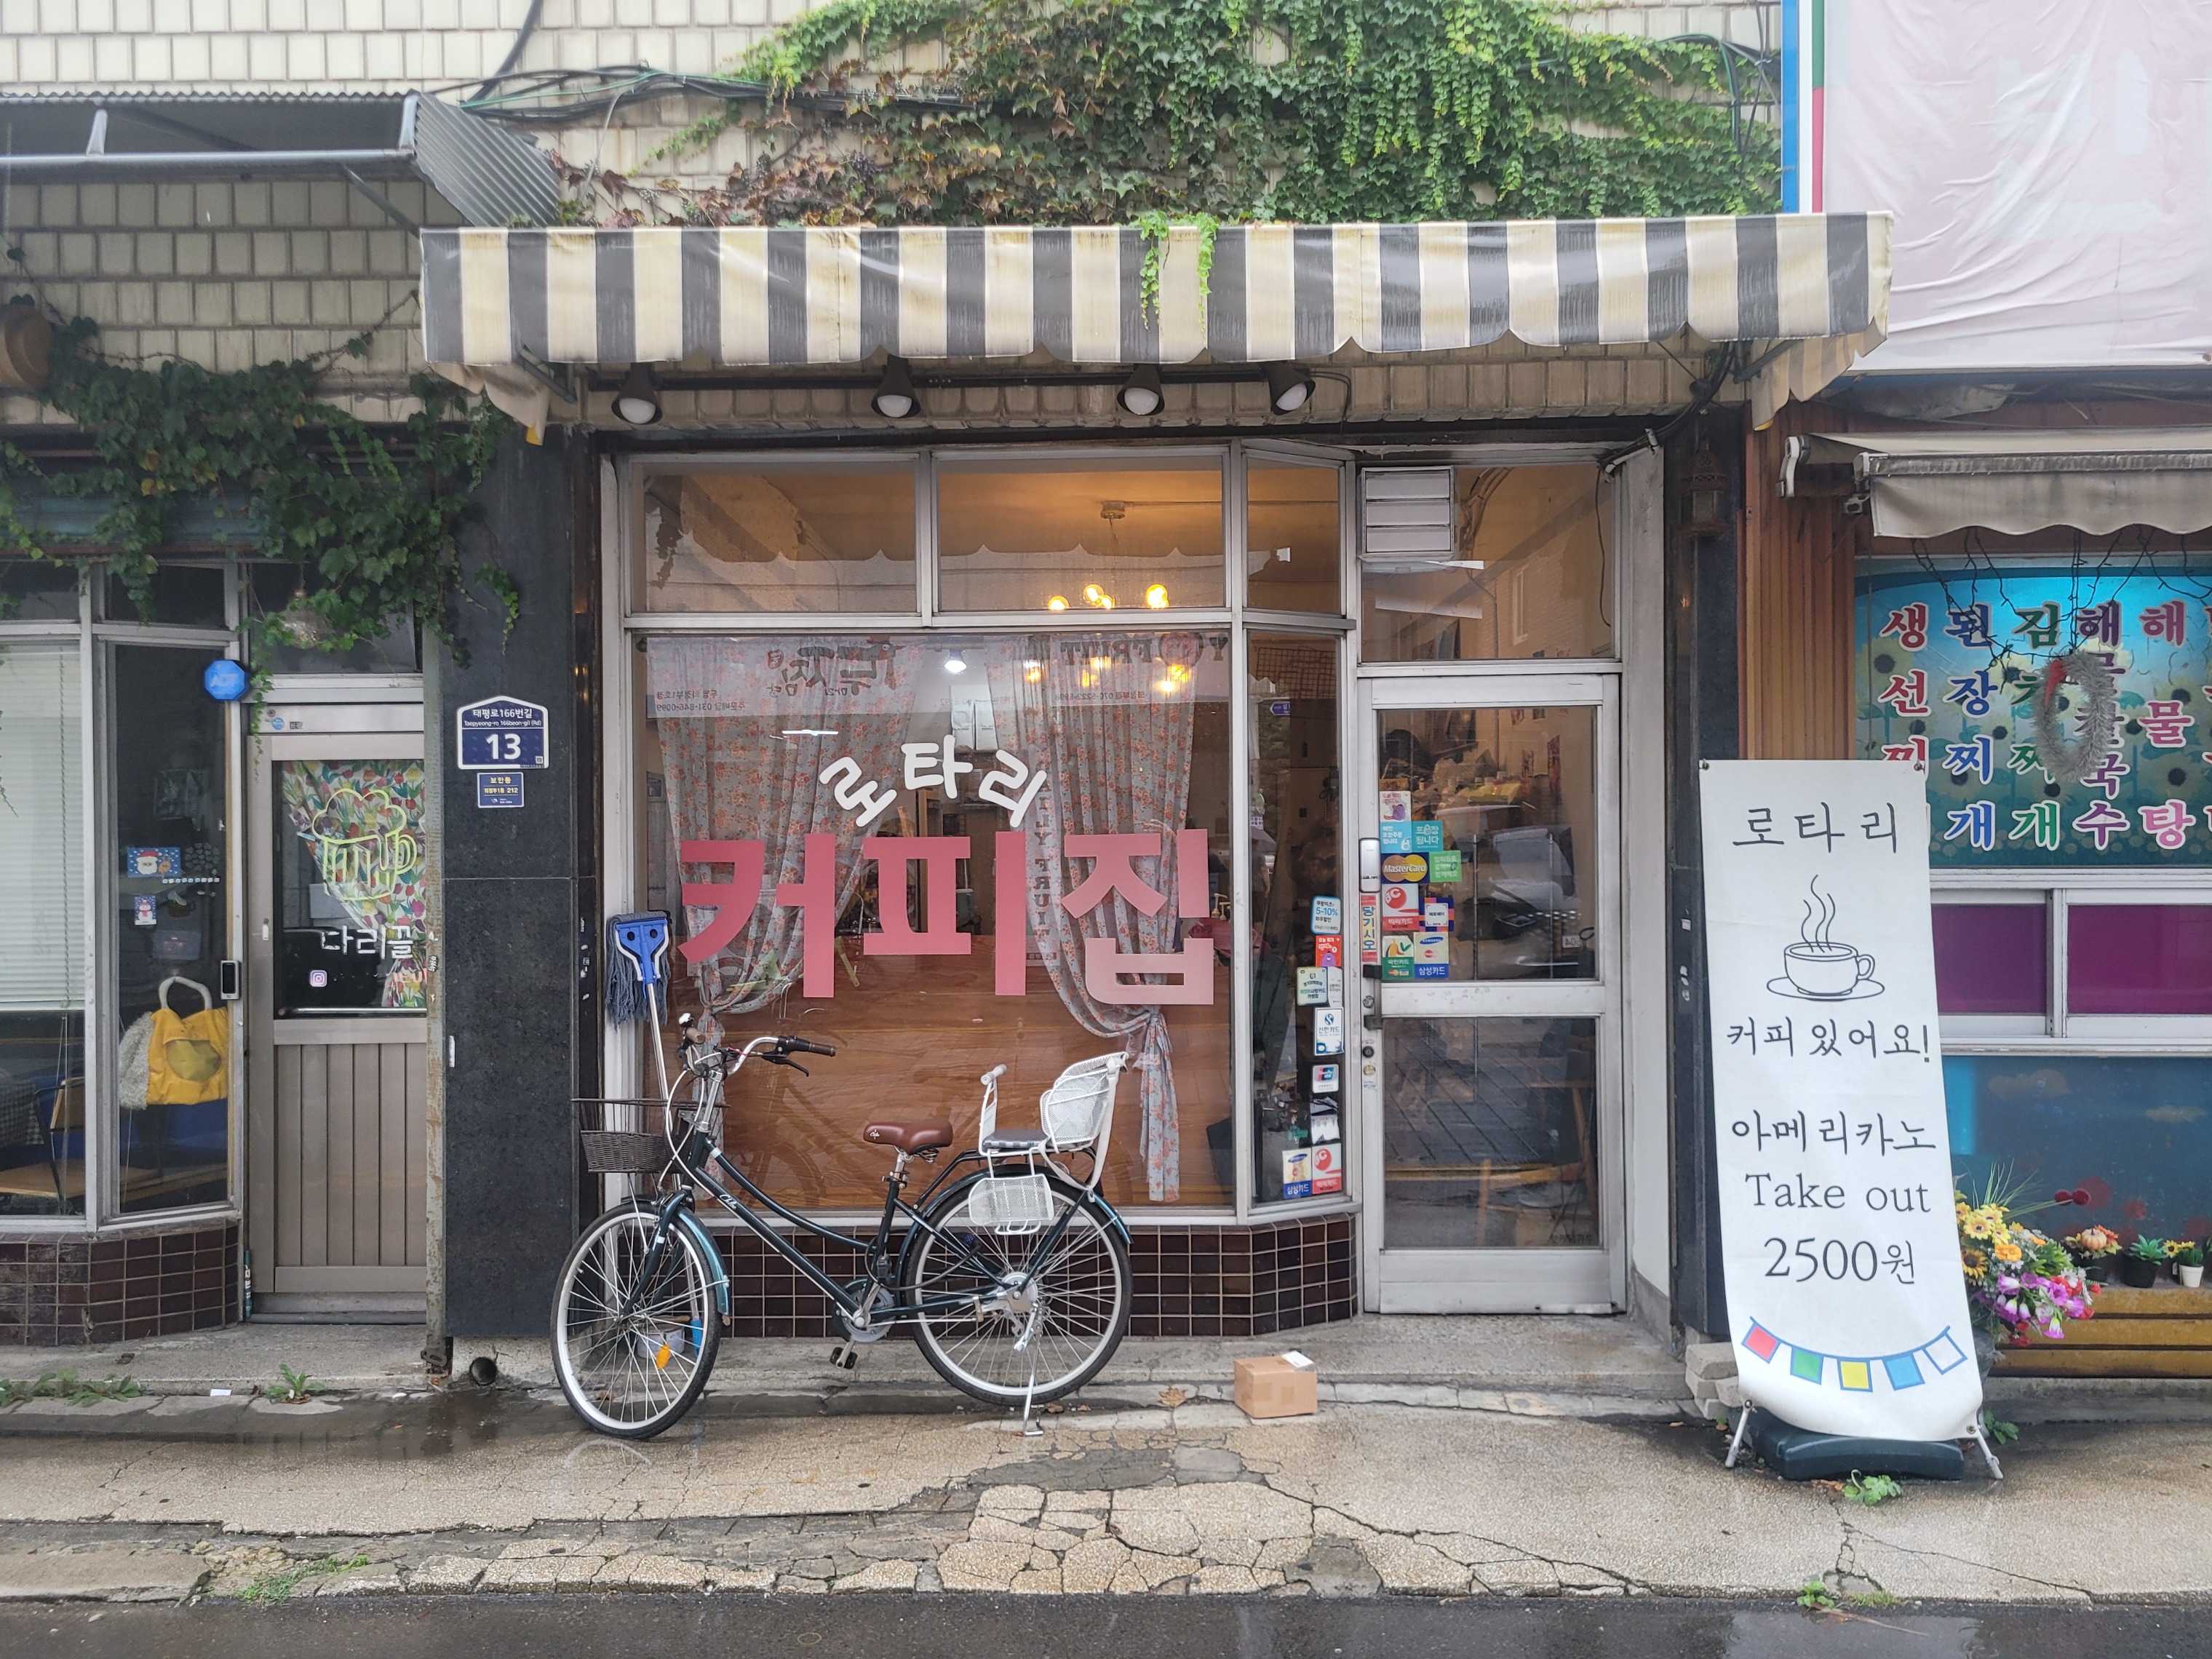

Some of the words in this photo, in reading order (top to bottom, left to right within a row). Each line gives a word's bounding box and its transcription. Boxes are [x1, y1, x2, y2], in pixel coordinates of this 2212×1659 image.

[472, 708, 533, 719] 태평로166번길
[1945, 604, 1999, 847] 된장찌개
[2139, 600, 2193, 843] 해물탕
[485, 733, 521, 760] 13
[819, 734, 1046, 827] 로타리
[1416, 835, 1439, 845] 됩니다
[1732, 801, 1897, 854] 로타리
[1383, 864, 1425, 873] MasterCard
[677, 828, 1214, 1006] 커피집
[1316, 907, 1338, 916] 5-10%
[1385, 888, 1401, 904] BC
[1362, 906, 1377, 950] 당기시오
[1418, 966, 1446, 976] 삼성카드
[1726, 1017, 1794, 1057] 커피
[1809, 1019, 1930, 1062] 있어요!
[1732, 1110, 1936, 1156] 아메리카노
[1286, 1184, 1310, 1195] 삼성카드
[1745, 1172, 1846, 1209] Take
[1866, 1184, 1931, 1212] out
[1764, 1238, 1915, 1284] 2500원
